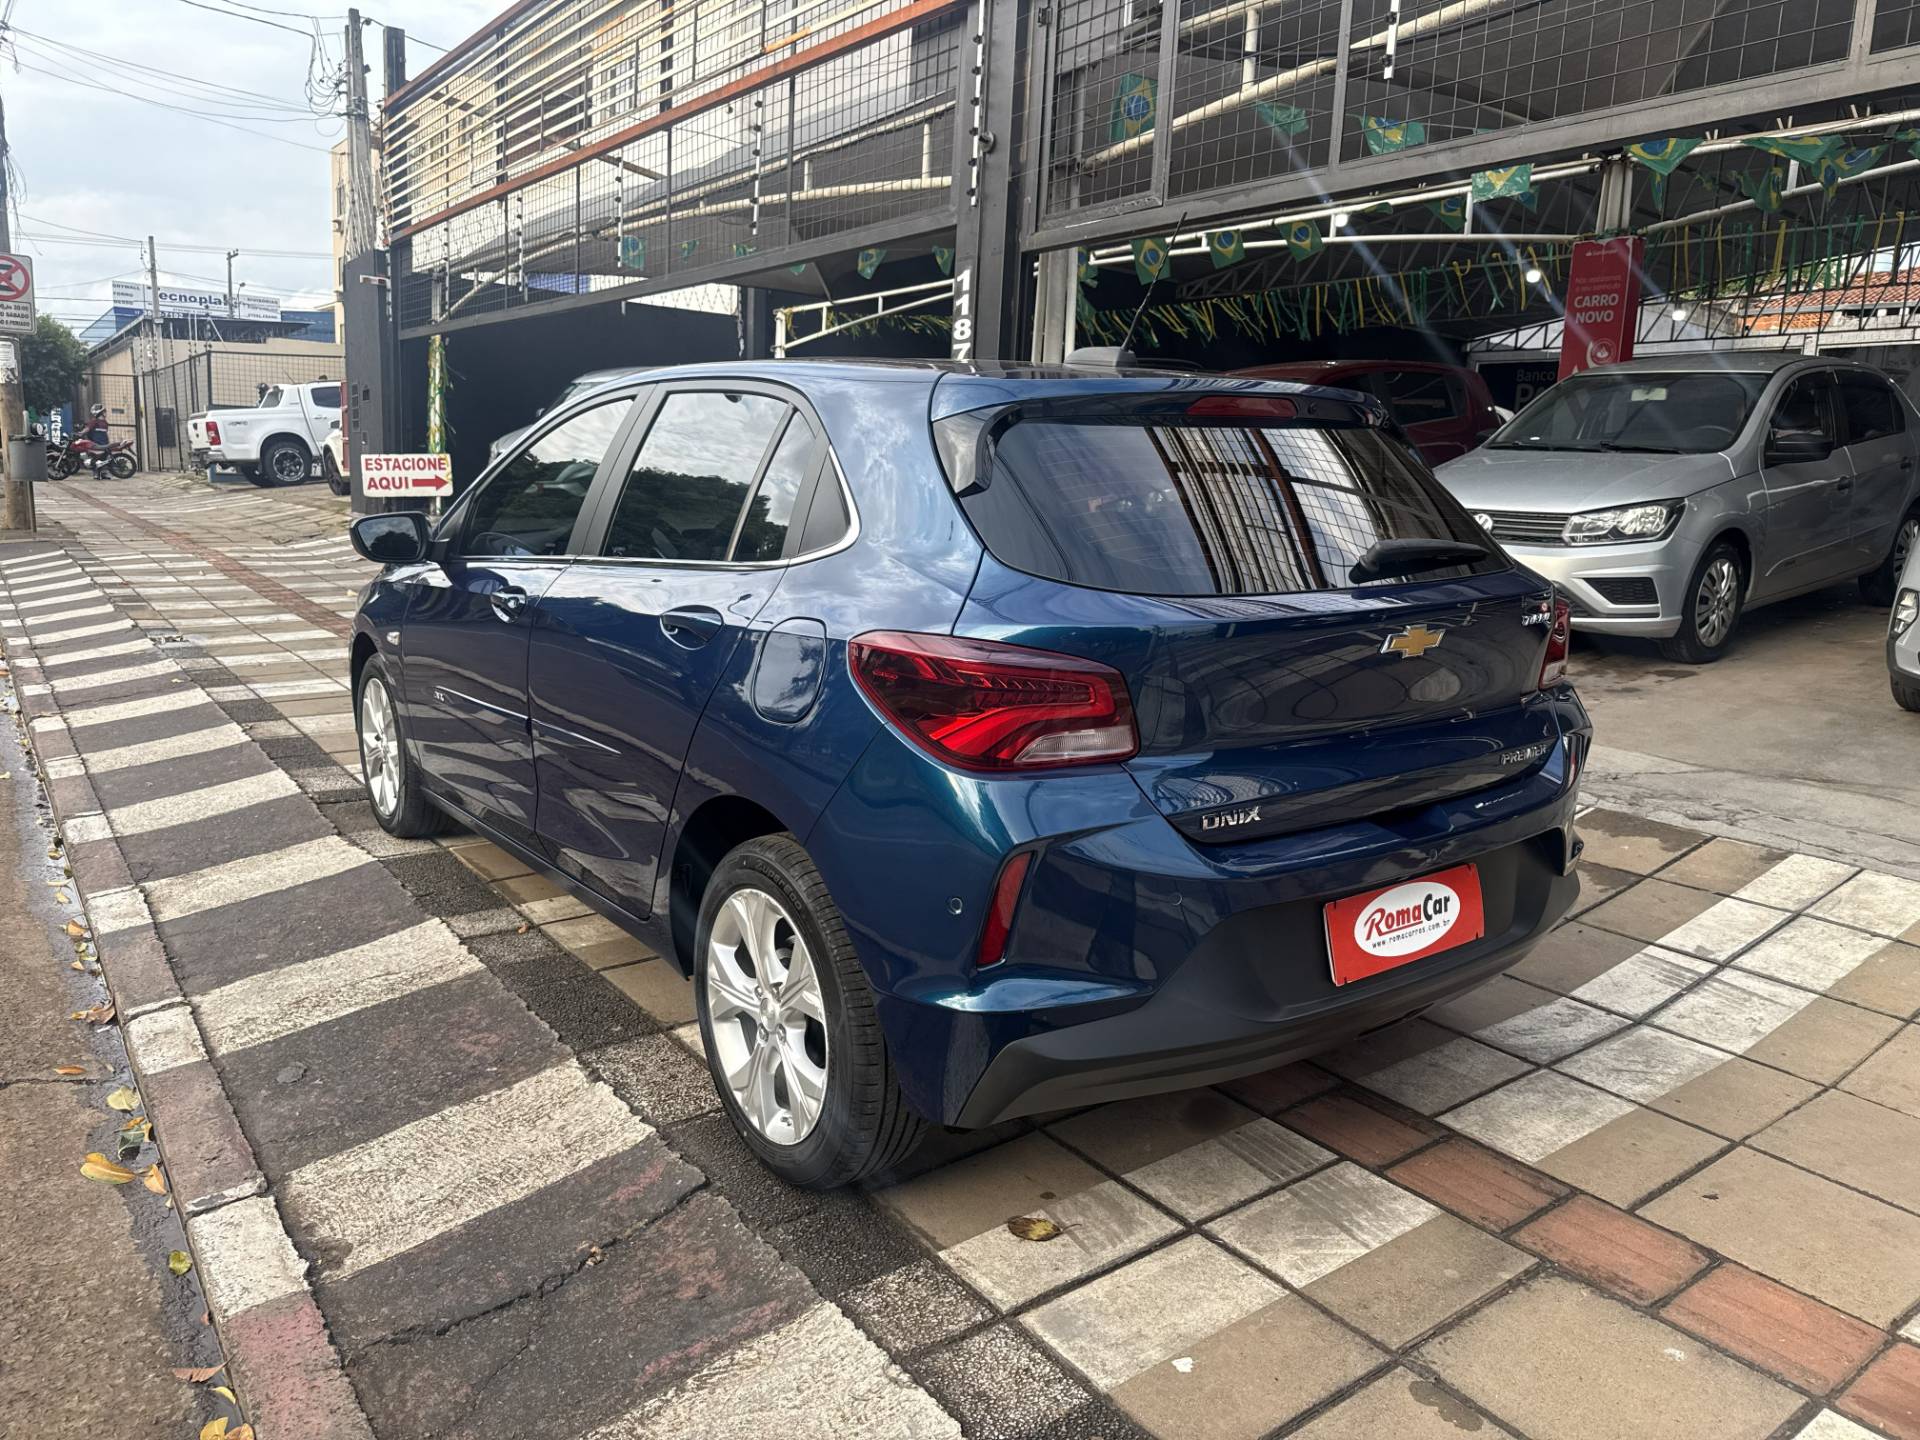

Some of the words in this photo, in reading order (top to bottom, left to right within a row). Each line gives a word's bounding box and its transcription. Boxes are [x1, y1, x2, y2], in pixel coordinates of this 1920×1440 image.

[147, 286, 230, 307] ecnopla
[1574, 293, 1619, 308] CARRO
[953, 269, 972, 361] 1187
[1575, 310, 1615, 324] NOVO
[1516, 369, 1556, 383] Banco
[364, 457, 447, 472] ESTACIONE
[367, 476, 409, 490] AQUI
[1501, 744, 1548, 765] PREMIER
[1202, 806, 1262, 831] ONIX
[1363, 893, 1451, 941] RomaCar
